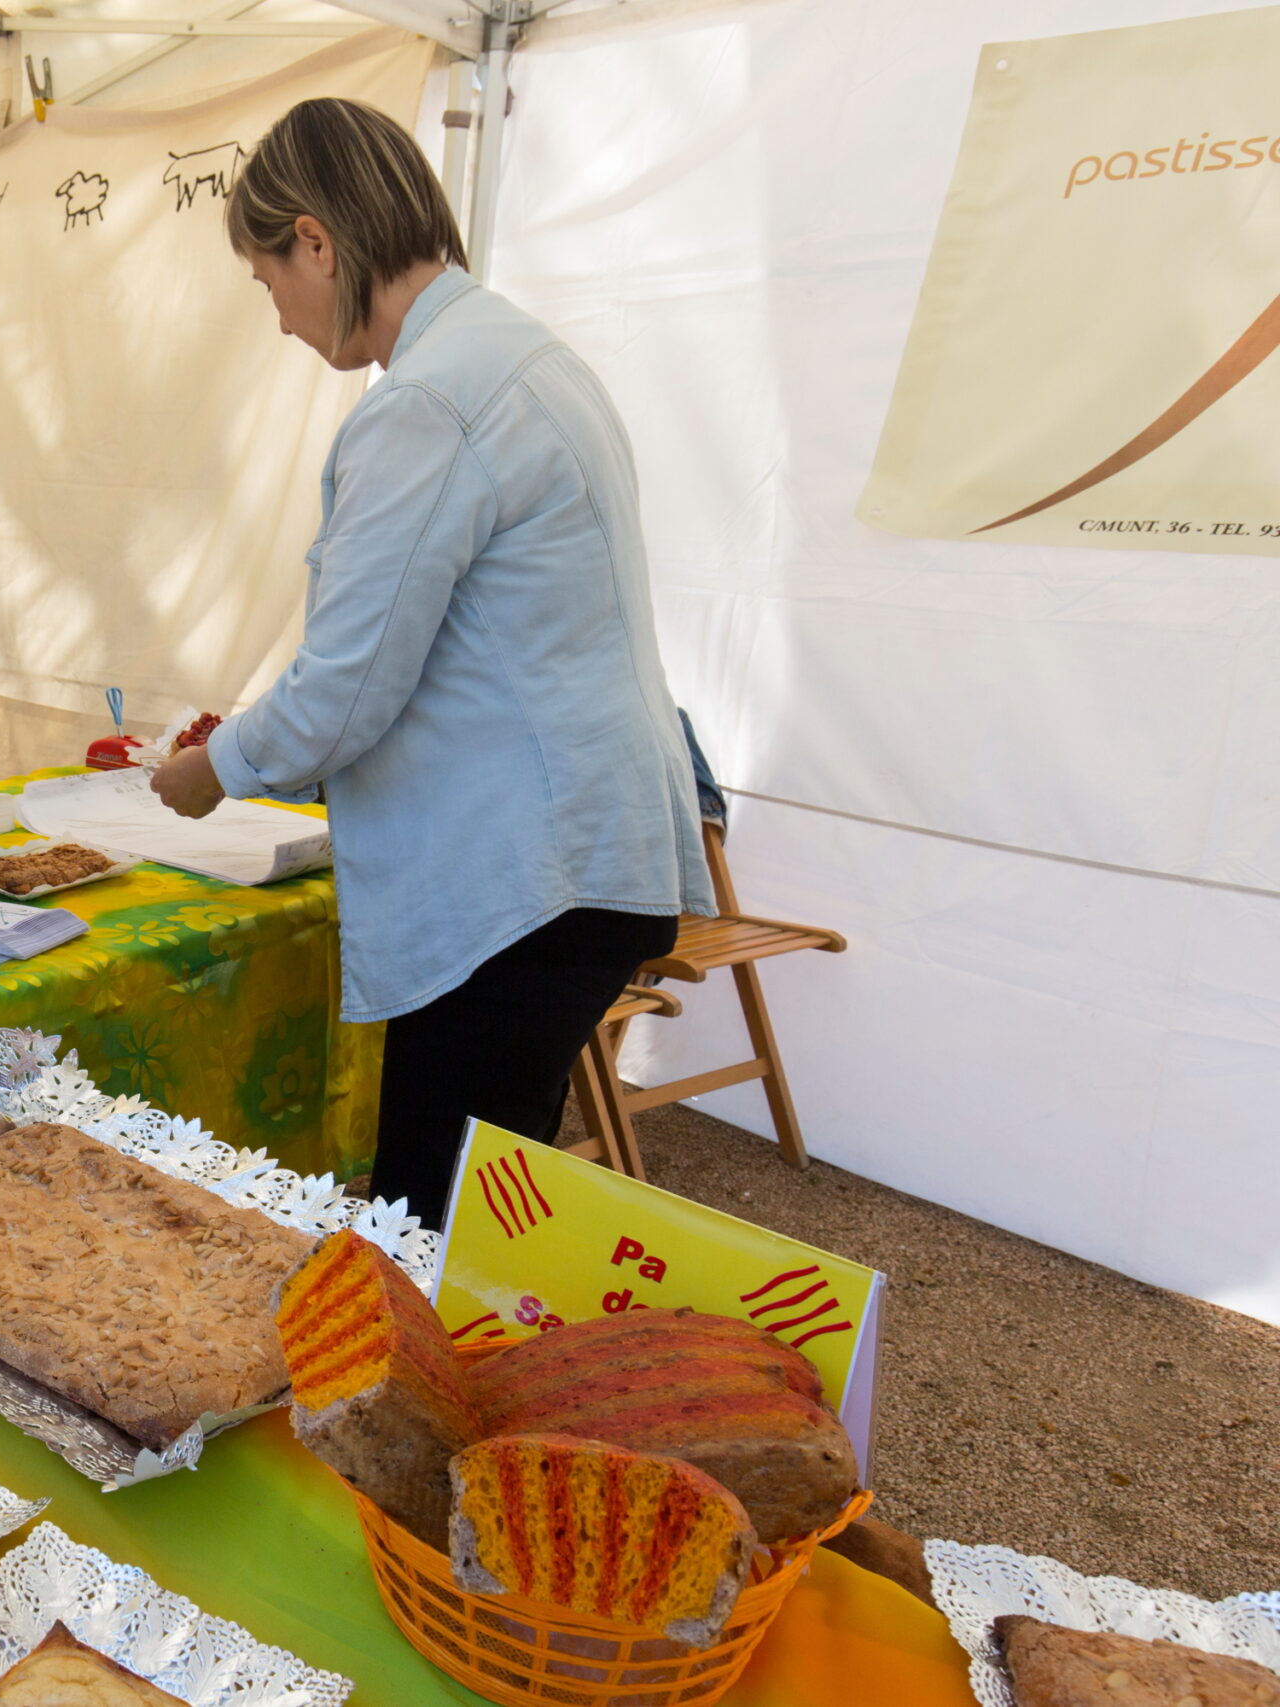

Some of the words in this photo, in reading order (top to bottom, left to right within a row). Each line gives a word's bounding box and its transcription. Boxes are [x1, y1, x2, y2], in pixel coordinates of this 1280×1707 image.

[1078, 519, 1160, 535] C/MUNT,
[1166, 521, 1193, 534] 36
[1209, 523, 1251, 536] TEL.
[610, 1235, 668, 1284] Pa
[602, 1288, 651, 1315] d
